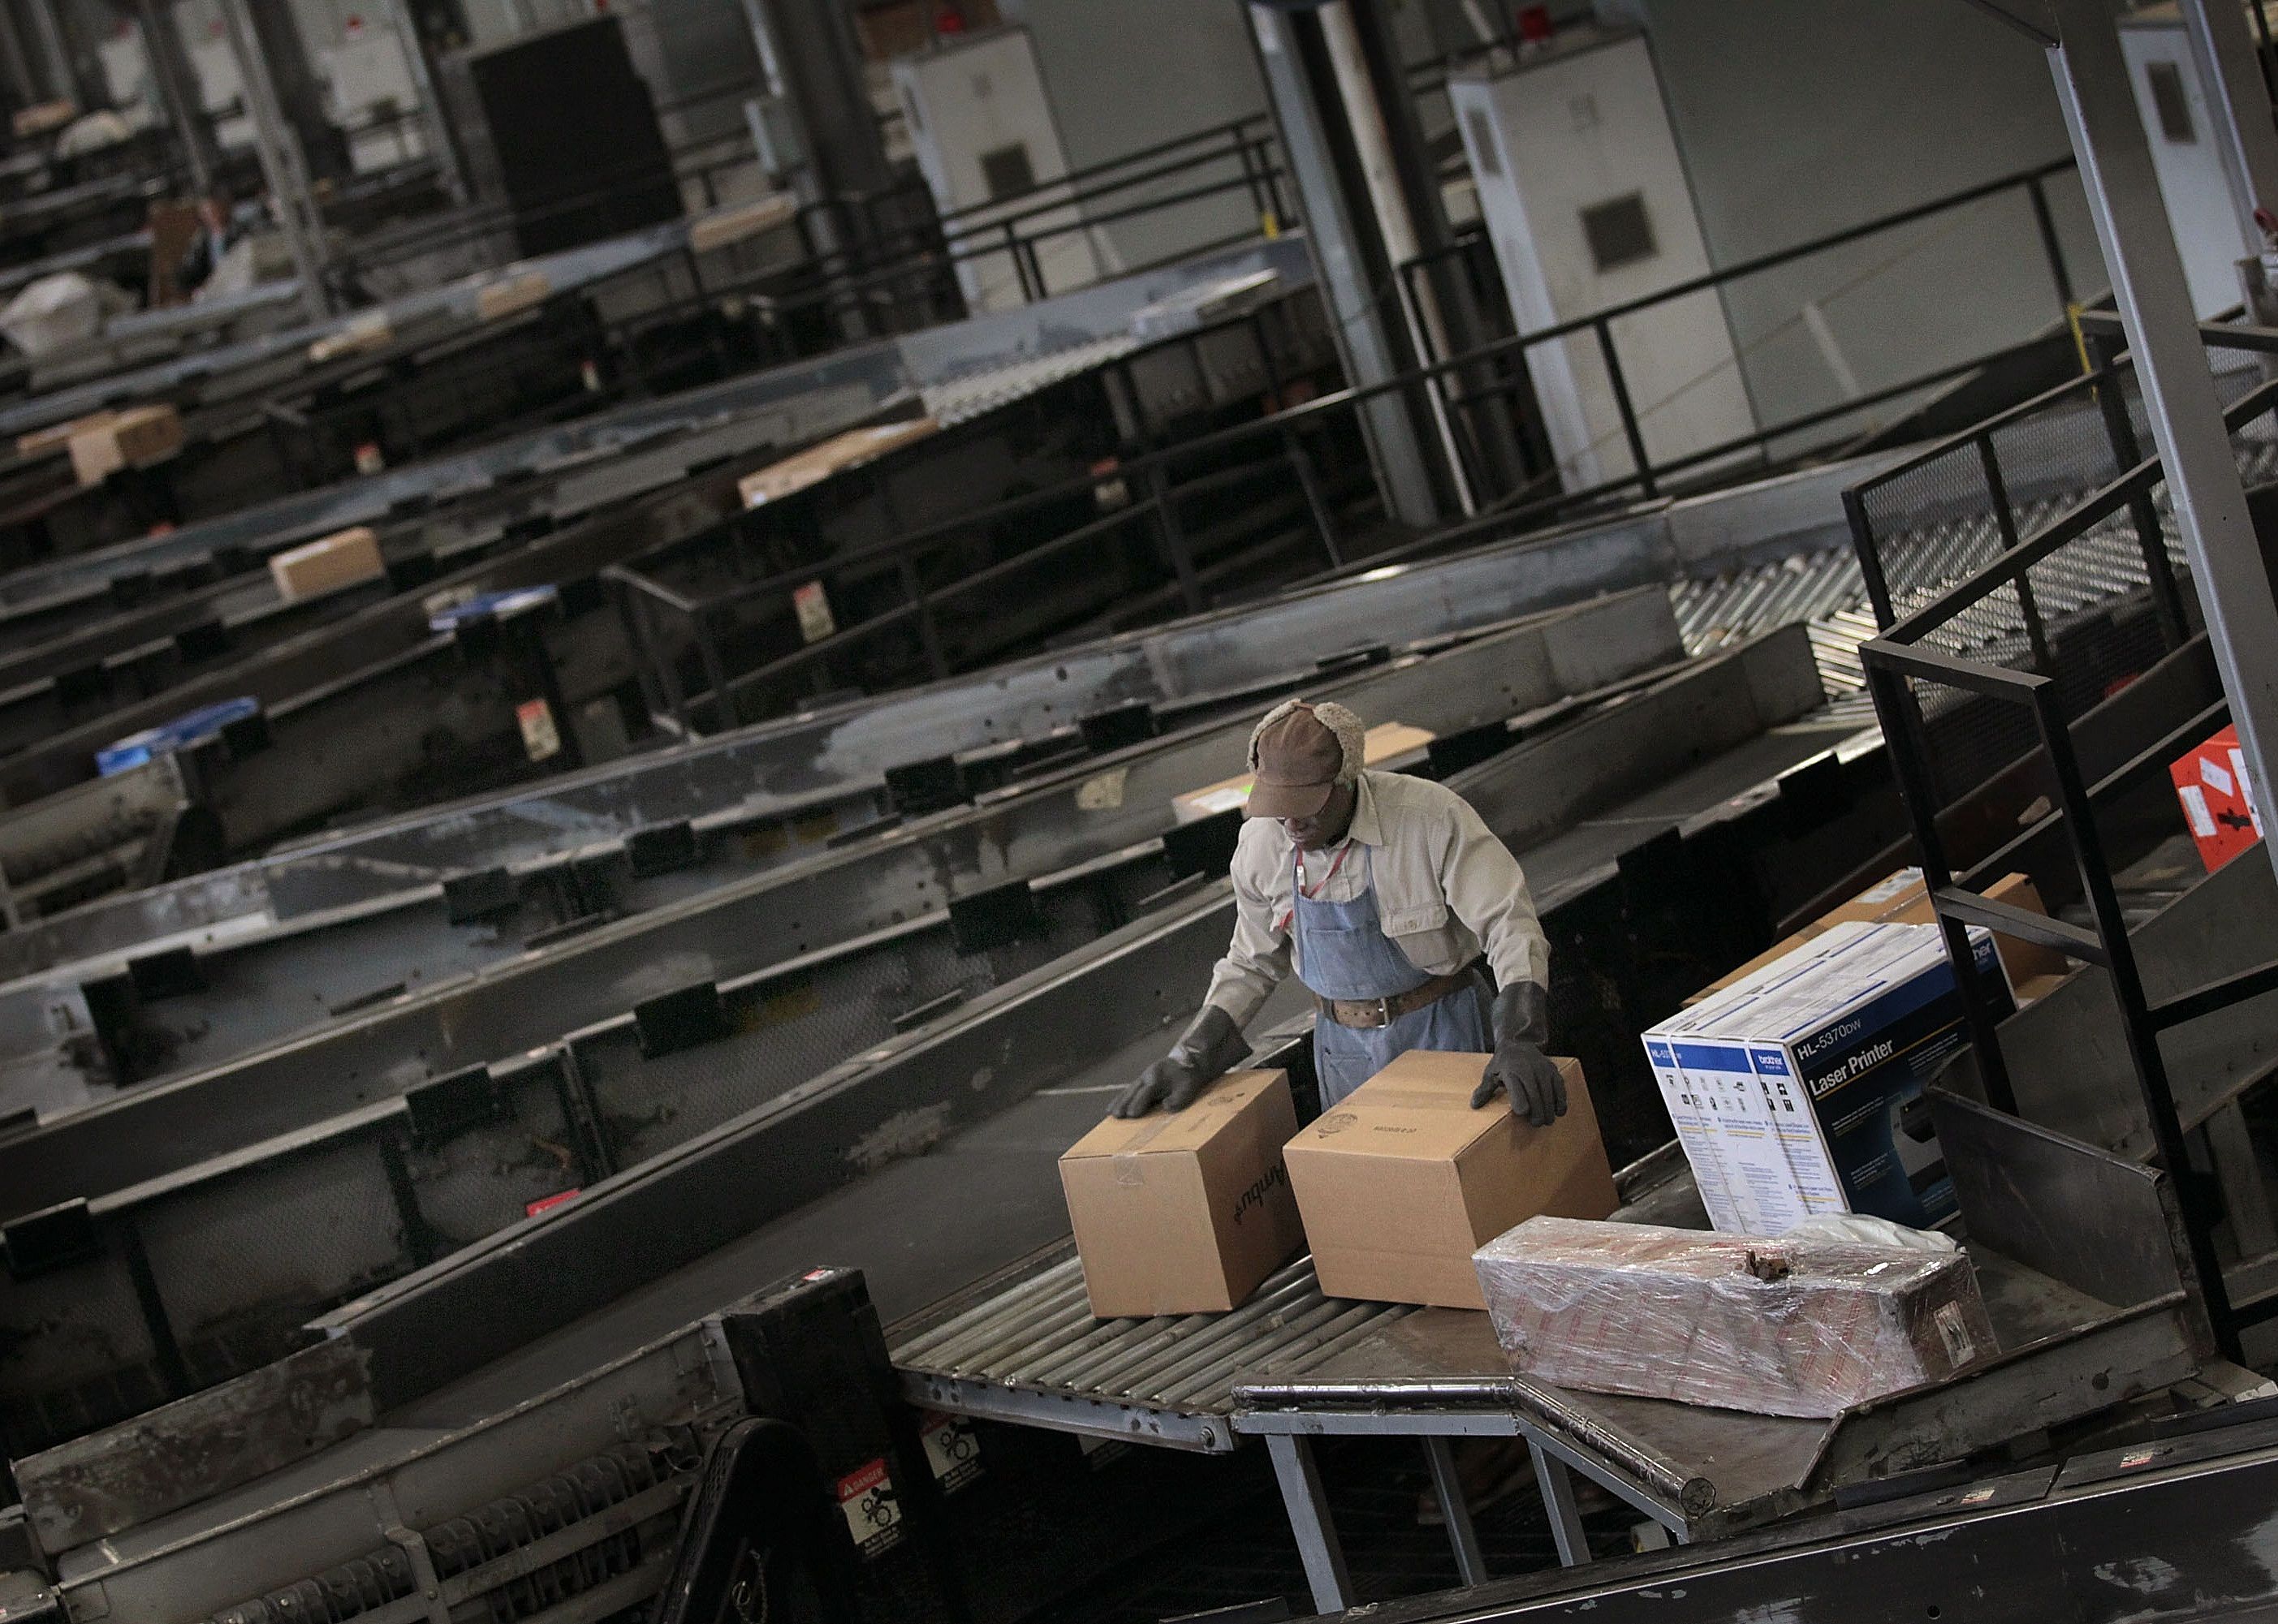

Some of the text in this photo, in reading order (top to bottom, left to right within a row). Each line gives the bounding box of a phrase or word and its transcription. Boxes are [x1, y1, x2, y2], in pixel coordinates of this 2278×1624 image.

[1758, 1054, 1783, 1066] brother
[1809, 1065, 1847, 1096] Laser
[1848, 1040, 1892, 1075] Printer
